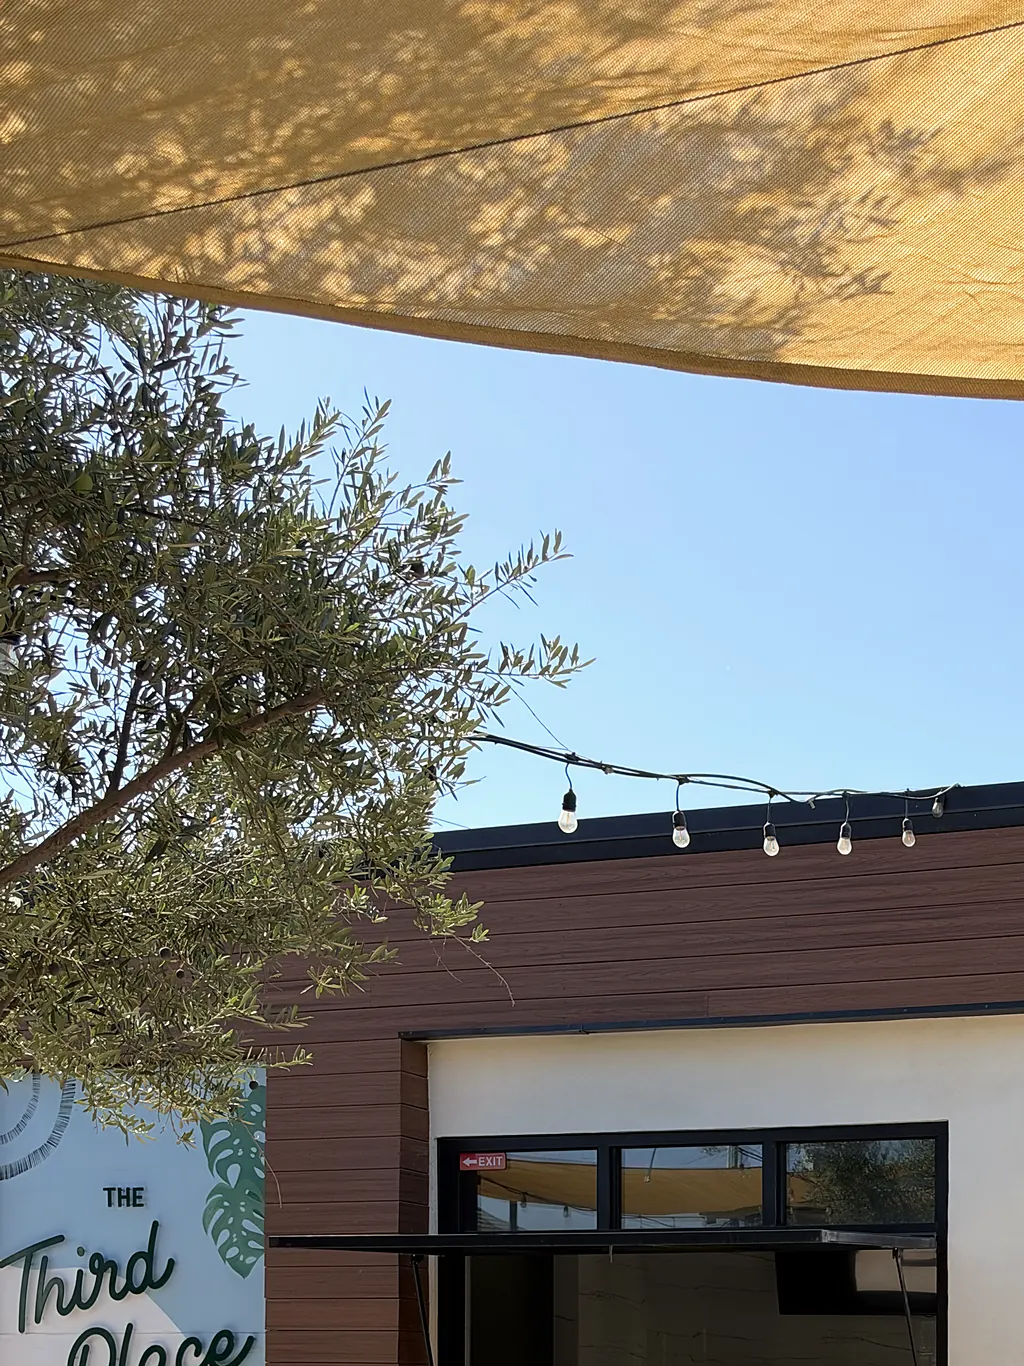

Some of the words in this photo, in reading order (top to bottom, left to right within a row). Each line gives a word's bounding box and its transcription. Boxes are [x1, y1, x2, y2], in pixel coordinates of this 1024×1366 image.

[478, 1156, 503, 1167] EXIT
[102, 1186, 146, 1209] THE
[0, 1220, 175, 1334] Third
